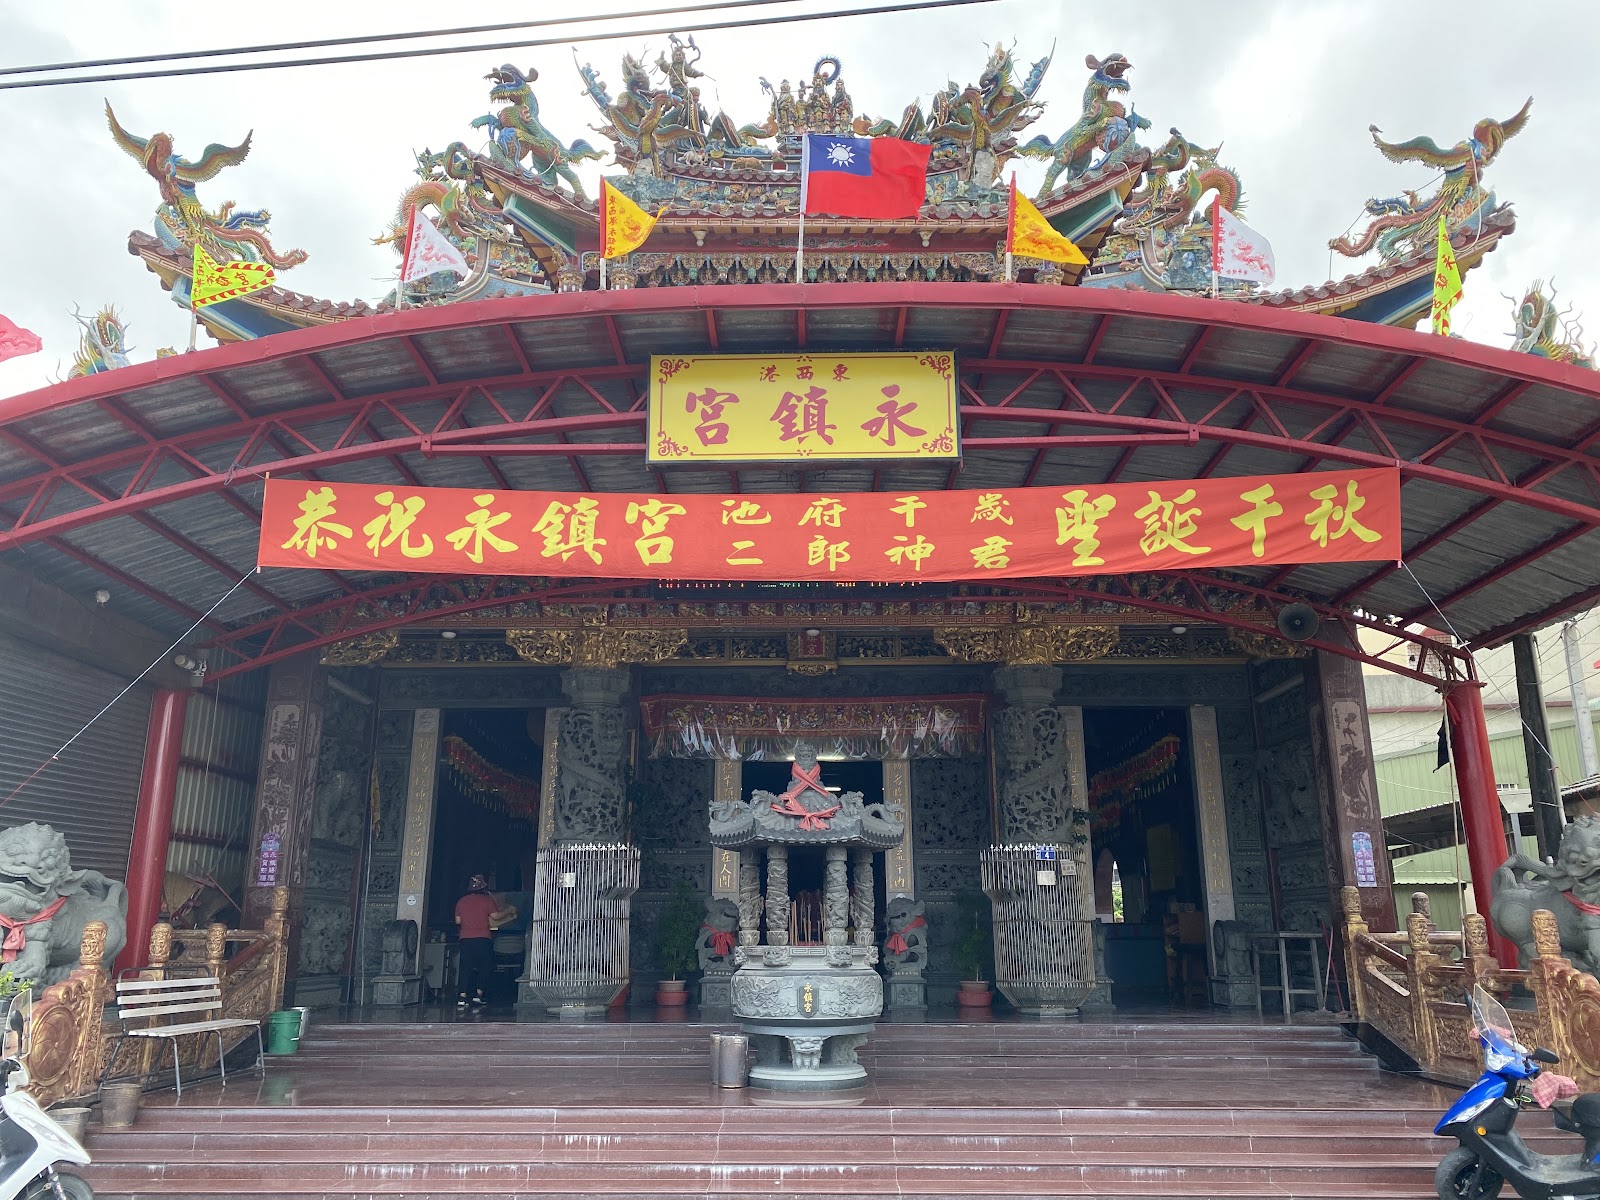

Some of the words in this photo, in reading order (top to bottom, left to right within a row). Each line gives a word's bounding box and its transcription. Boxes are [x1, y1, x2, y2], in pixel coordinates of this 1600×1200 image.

[685, 384, 927, 446] 永鎮宮
[281, 487, 686, 564] 恭祝永鎮宮
[726, 534, 1013, 572] 二郎神君
[1055, 480, 1382, 567] 聖誕千秋
